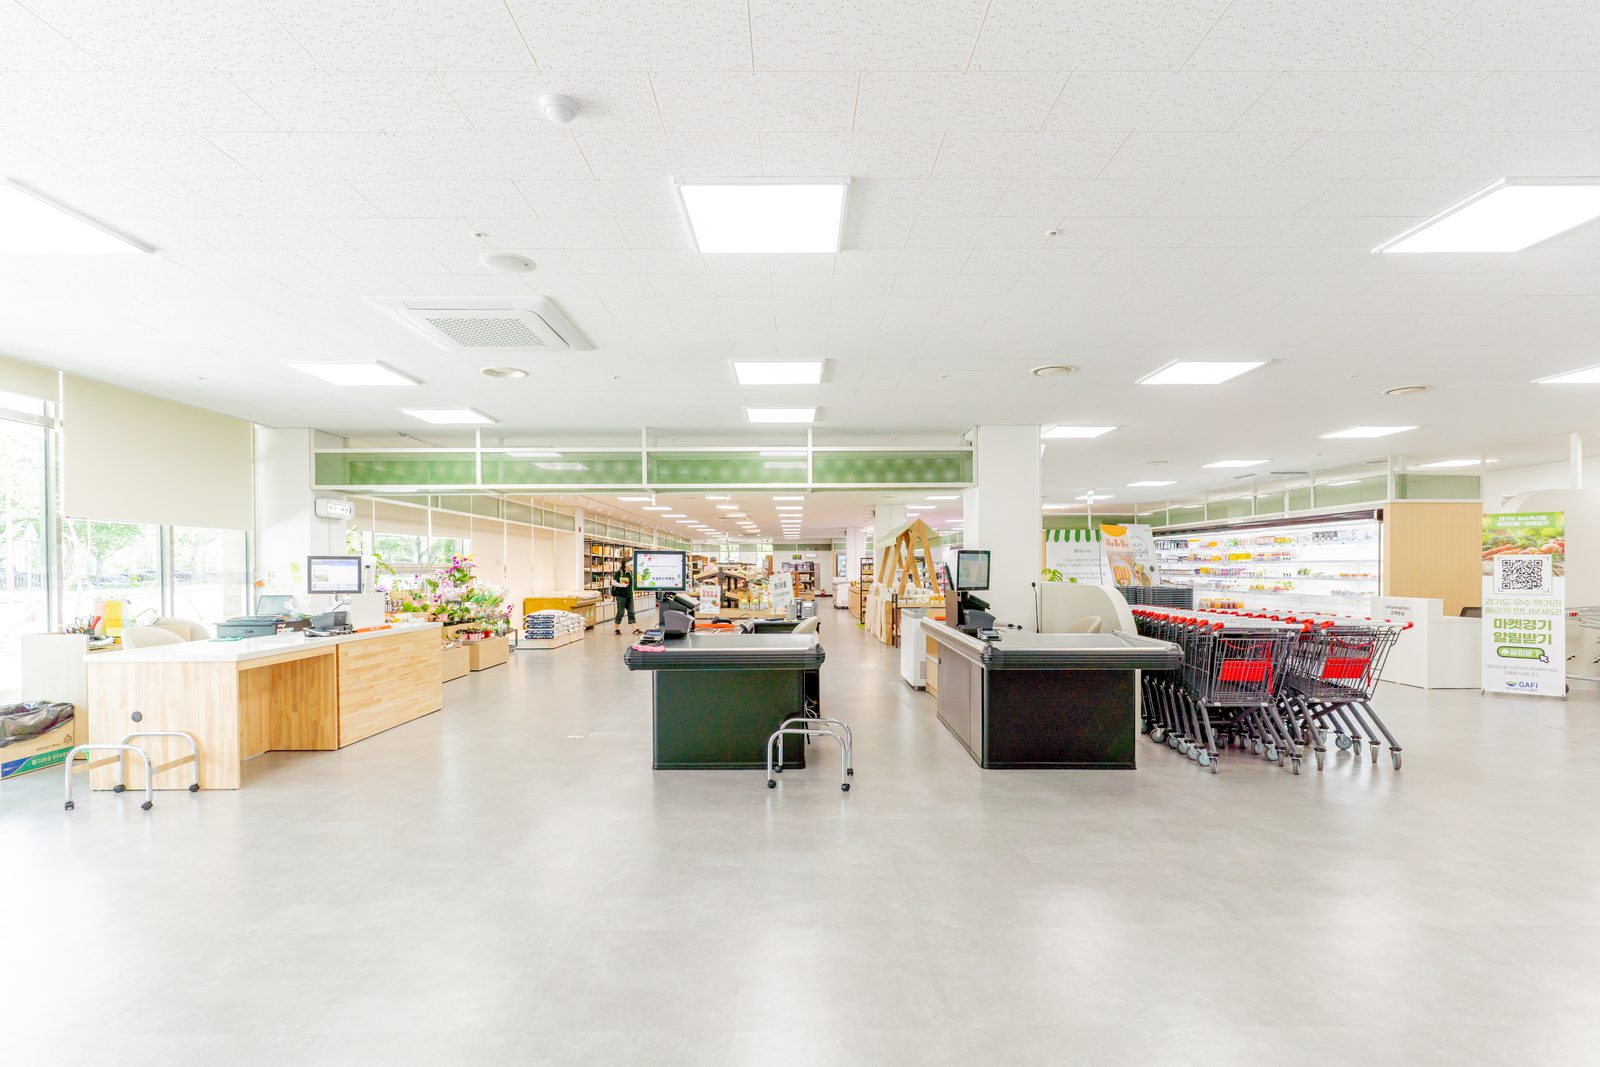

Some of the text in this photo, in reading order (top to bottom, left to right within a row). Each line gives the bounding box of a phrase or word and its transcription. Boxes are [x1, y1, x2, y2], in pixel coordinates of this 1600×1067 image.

[1485, 598, 1512, 606] 경기도
[1533, 599, 1561, 607] 먹거리
[1493, 618, 1552, 631] 마켓경기
[1493, 631, 1552, 645] 알림받기
[1518, 681, 1538, 689] GAFI
